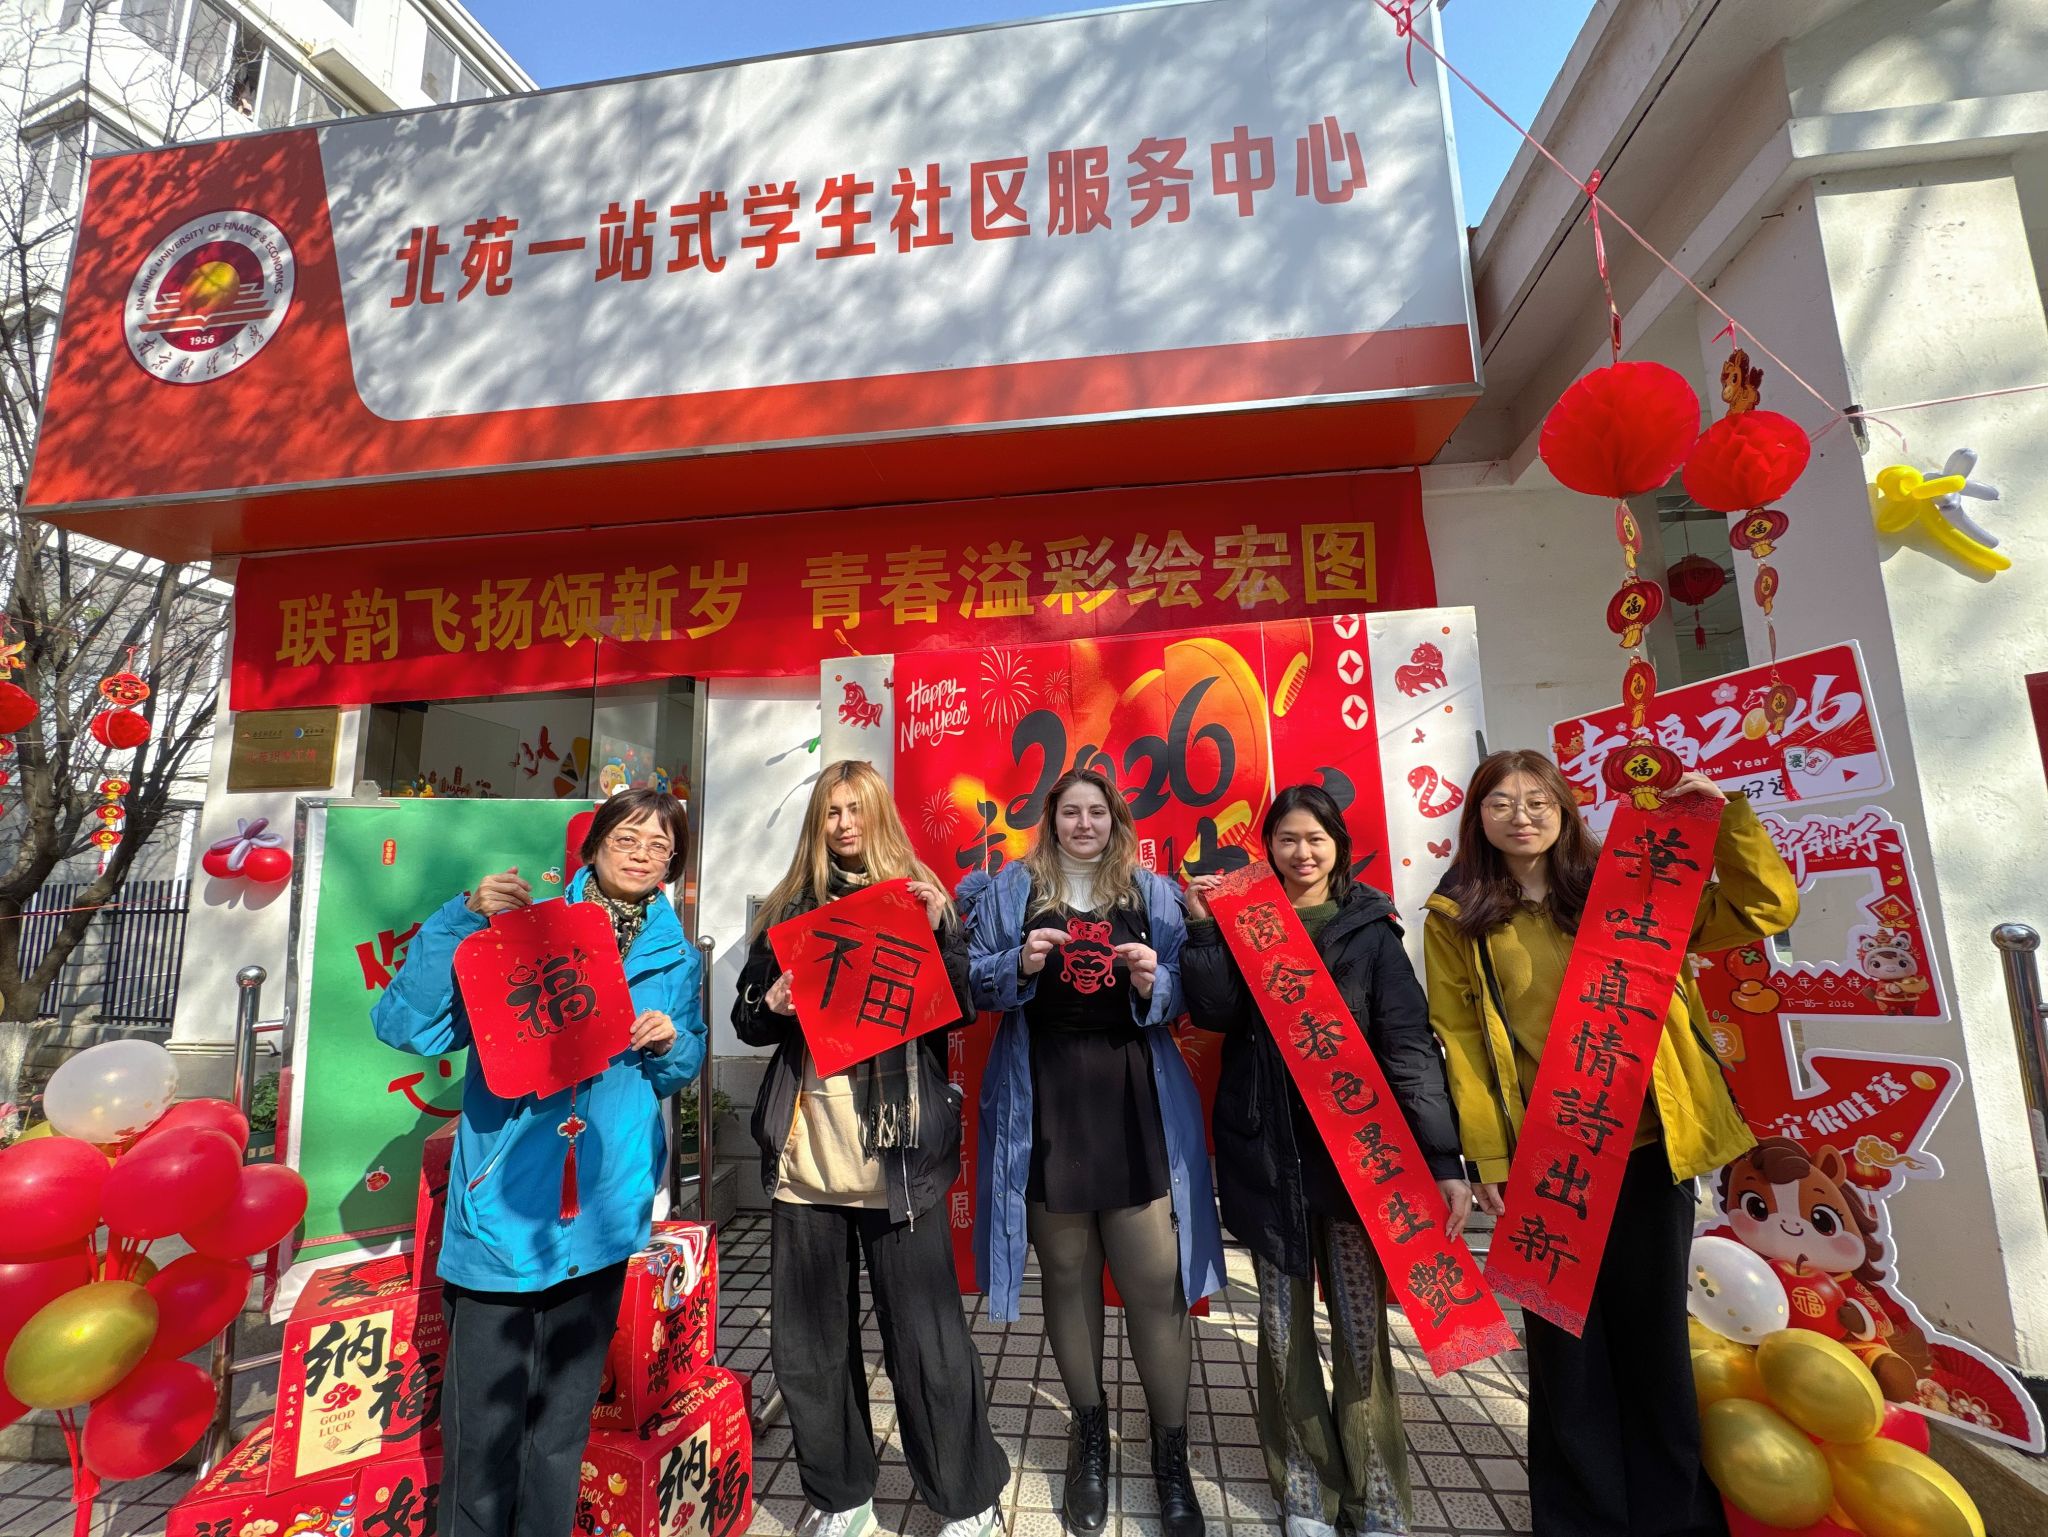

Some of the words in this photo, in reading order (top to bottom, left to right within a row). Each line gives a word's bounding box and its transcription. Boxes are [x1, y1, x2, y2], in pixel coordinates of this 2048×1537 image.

[390, 115, 1369, 307] 北苑一站式学生社区服务中心
[135, 267, 158, 312] NANJING
[157, 226, 206, 268] UNIVERSITY
[208, 222, 223, 233] OF
[224, 222, 261, 239] FINANCE
[259, 234, 267, 244] &
[264, 241, 285, 295] ECONOMICS
[189, 334, 215, 346] 1956
[276, 559, 749, 667] 联韵飞扬颂新岁
[800, 521, 1378, 630] 青春溢彩绘宏图
[1625, 596, 1642, 617] 福
[907, 676, 966, 712] Happy
[900, 711, 933, 753] New
[929, 702, 971, 747] Year
[1630, 758, 1654, 778] 福
[1733, 756, 1769, 770] Year
[811, 917, 930, 1037] 福
[1776, 976, 1861, 989] 马年吉祥
[506, 954, 597, 1036] 福
[1827, 1000, 1855, 1008] 2026
[1791, 1286, 1827, 1318] 福
[418, 1325, 442, 1337] New
[416, 1337, 442, 1349] Year
[319, 1409, 355, 1426] GOOD
[318, 1421, 352, 1438] LUCK
